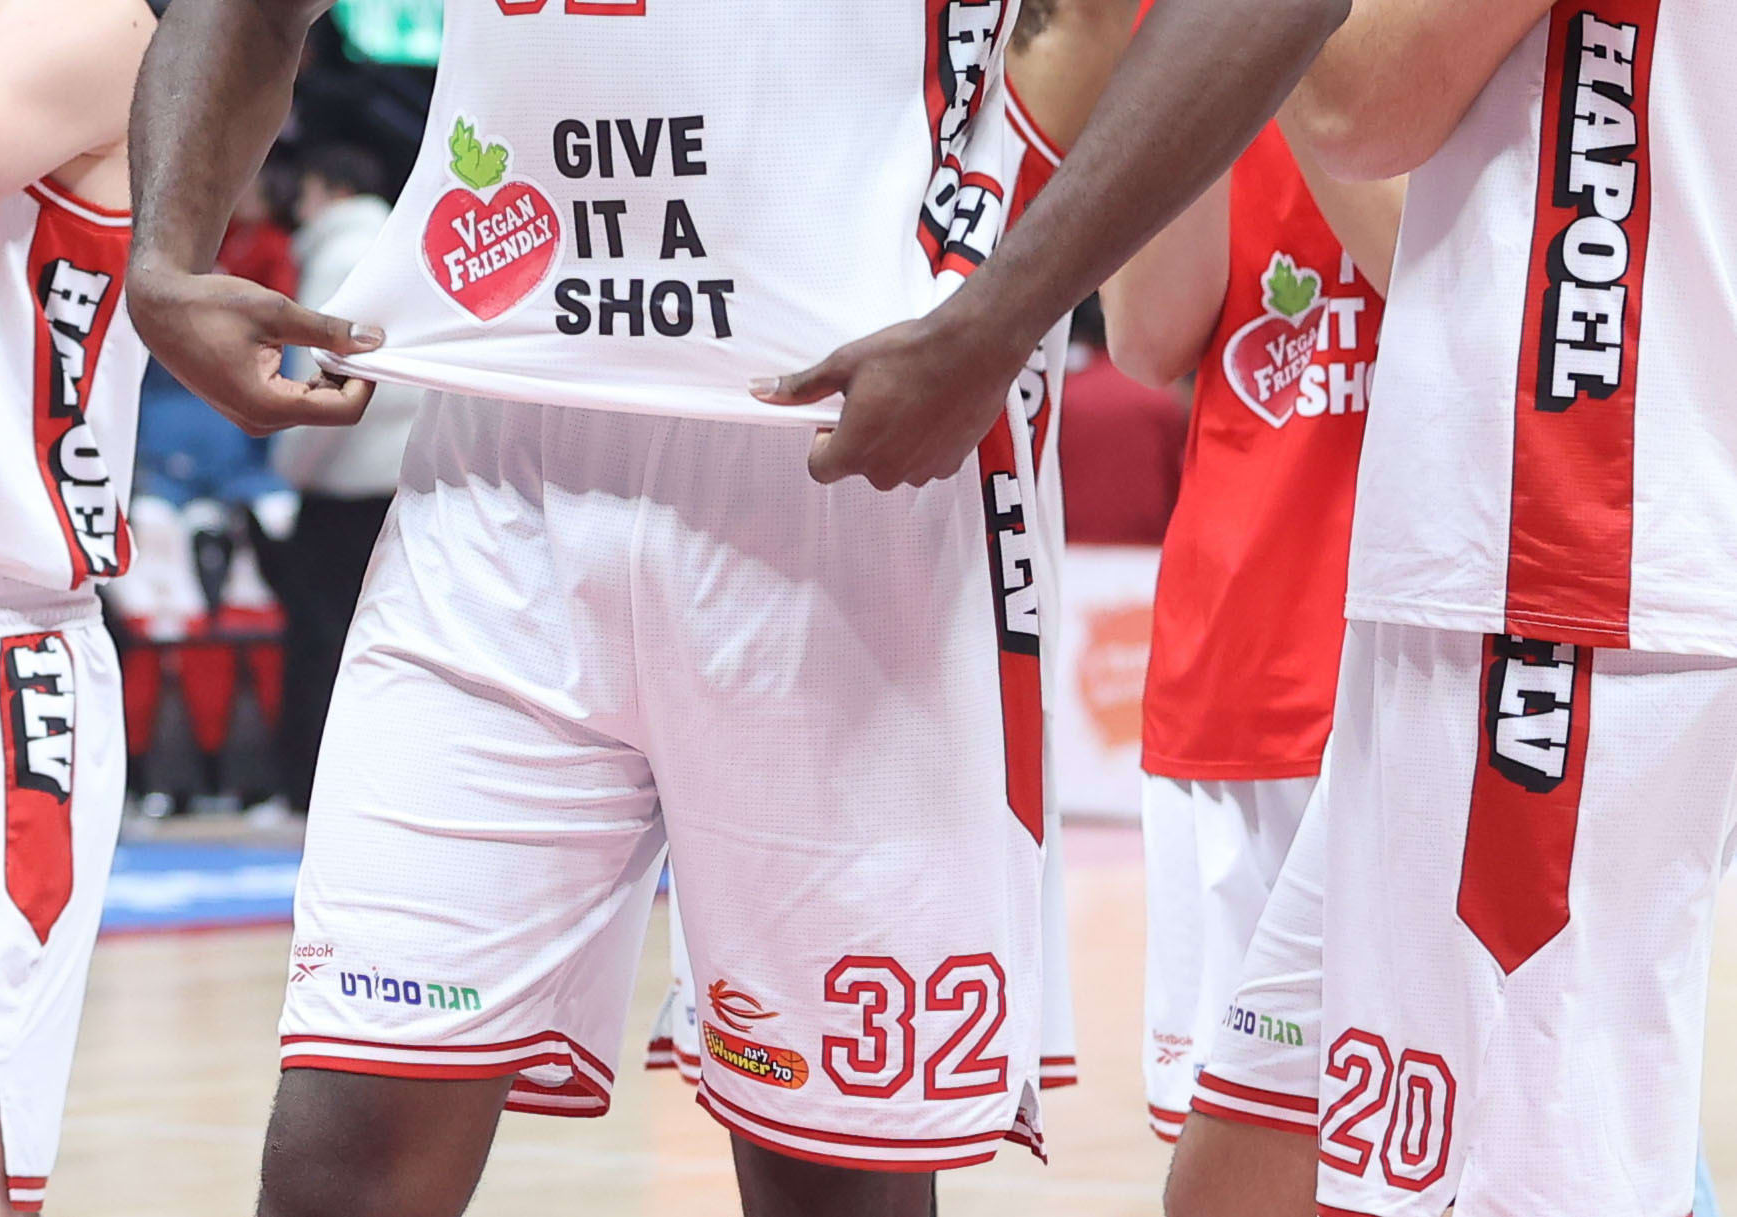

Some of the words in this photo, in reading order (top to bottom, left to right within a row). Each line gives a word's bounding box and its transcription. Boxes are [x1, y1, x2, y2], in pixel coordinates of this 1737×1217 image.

[552, 114, 708, 180] GIVE
[451, 193, 537, 254] VEGAN
[572, 199, 628, 259] IT
[659, 198, 708, 260] A
[1545, 10, 1639, 401] HAPOEL
[442, 214, 554, 293] FRIENDLY
[553, 277, 735, 339] SHOT
[11, 634, 75, 798] TLV
[710, 1034, 771, 1076] Winner
[821, 951, 1009, 1101] 32
[1319, 1026, 1457, 1193] 20
